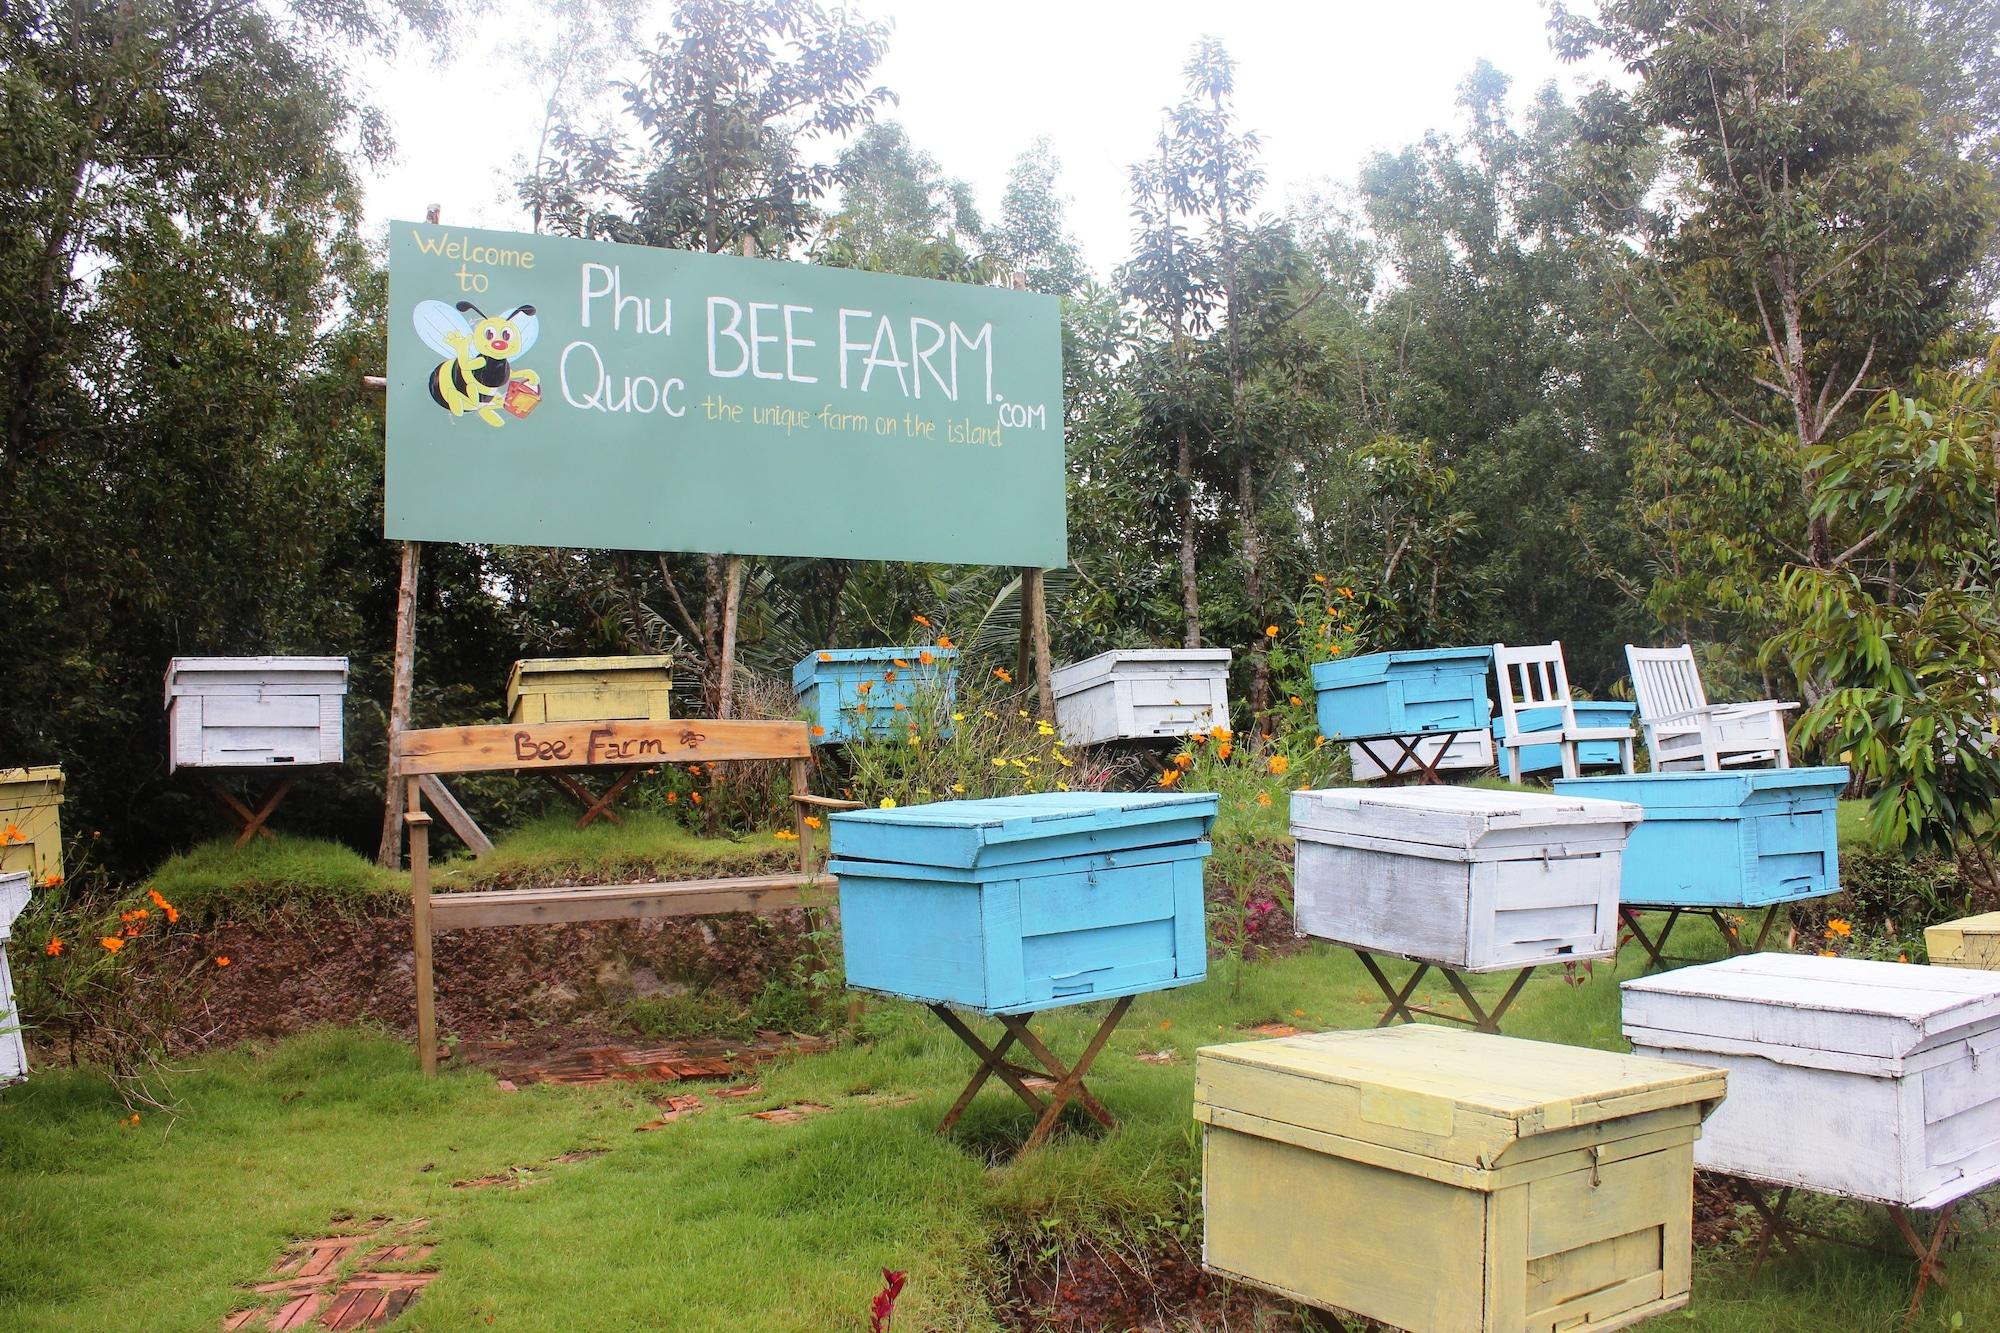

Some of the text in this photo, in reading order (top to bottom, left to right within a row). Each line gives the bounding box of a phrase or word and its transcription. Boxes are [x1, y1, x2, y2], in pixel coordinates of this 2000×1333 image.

[412, 230, 536, 269] Welcome
[456, 263, 489, 292] to
[581, 262, 672, 336] Phu
[707, 296, 818, 383] BEE
[560, 341, 686, 417] Quoc
[701, 395, 1003, 447] the unique farm on the island
[514, 728, 667, 764] Bee Farm
